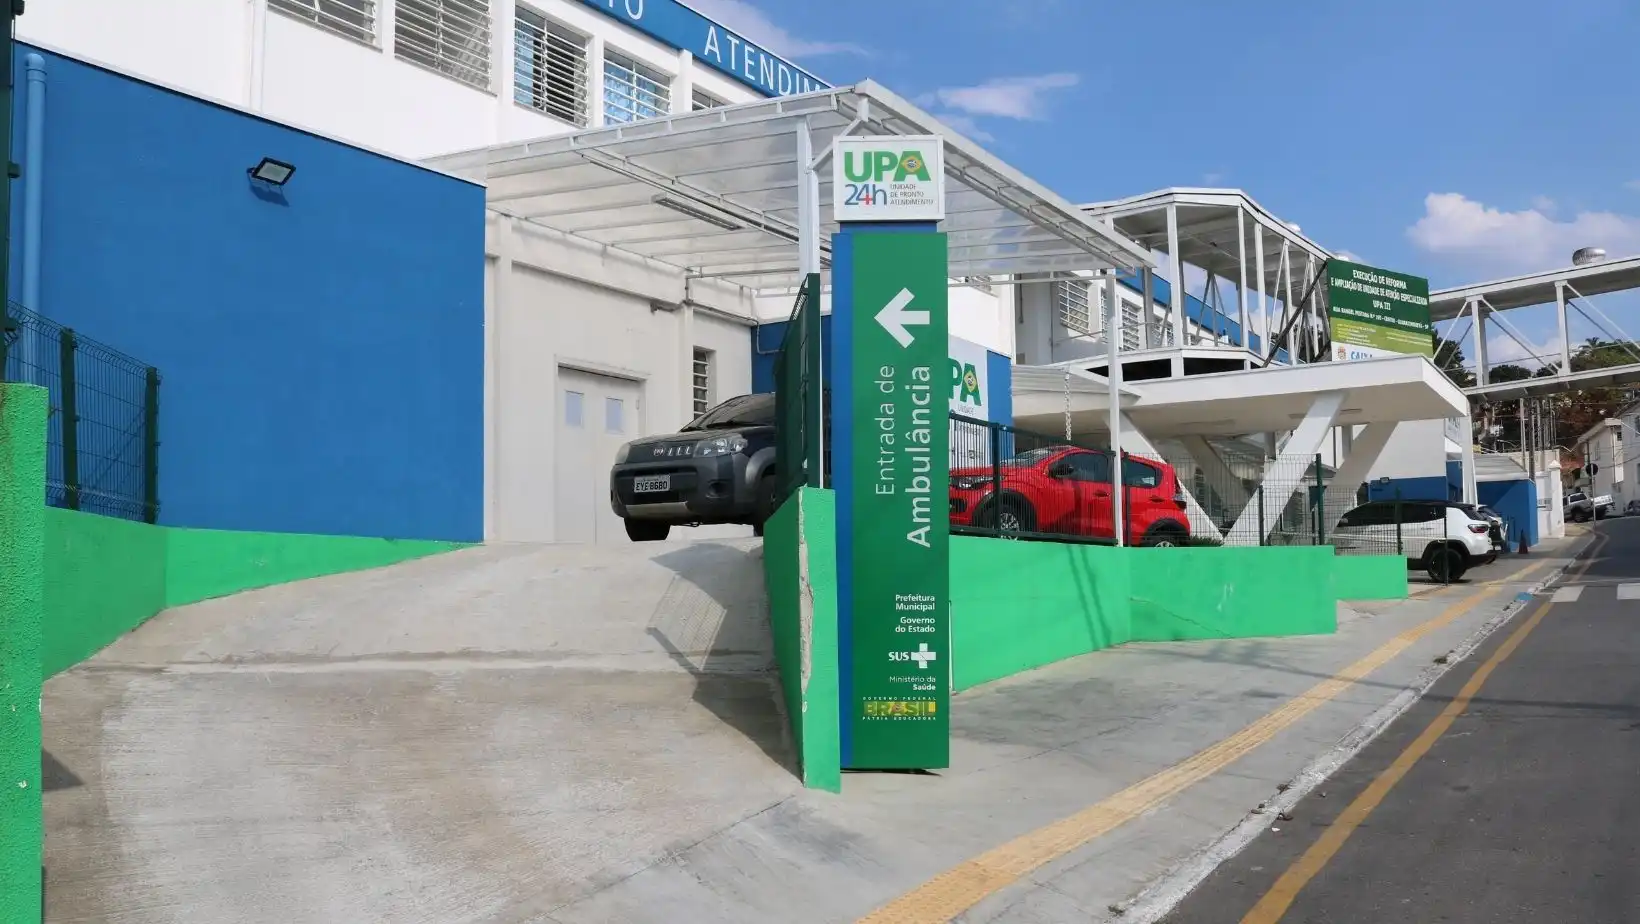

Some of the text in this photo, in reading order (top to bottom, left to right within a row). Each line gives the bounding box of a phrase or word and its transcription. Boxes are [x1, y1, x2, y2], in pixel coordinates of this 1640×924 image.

[608, 0, 643, 20] O
[844, 151, 931, 182] UPA
[844, 184, 887, 205] 24h
[1352, 269, 1407, 290] EXECUÇÃO DE REFORMA
[1373, 300, 1384, 309] UPA
[874, 365, 895, 495] Entrada de
[905, 366, 931, 548] Ambulância
[895, 594, 935, 602] Prefeitura
[895, 603, 935, 612] Municipal
[900, 616, 936, 624] Governo
[895, 625, 936, 633] do Estado
[888, 651, 910, 662] SUS
[913, 683, 936, 691] Saúde
